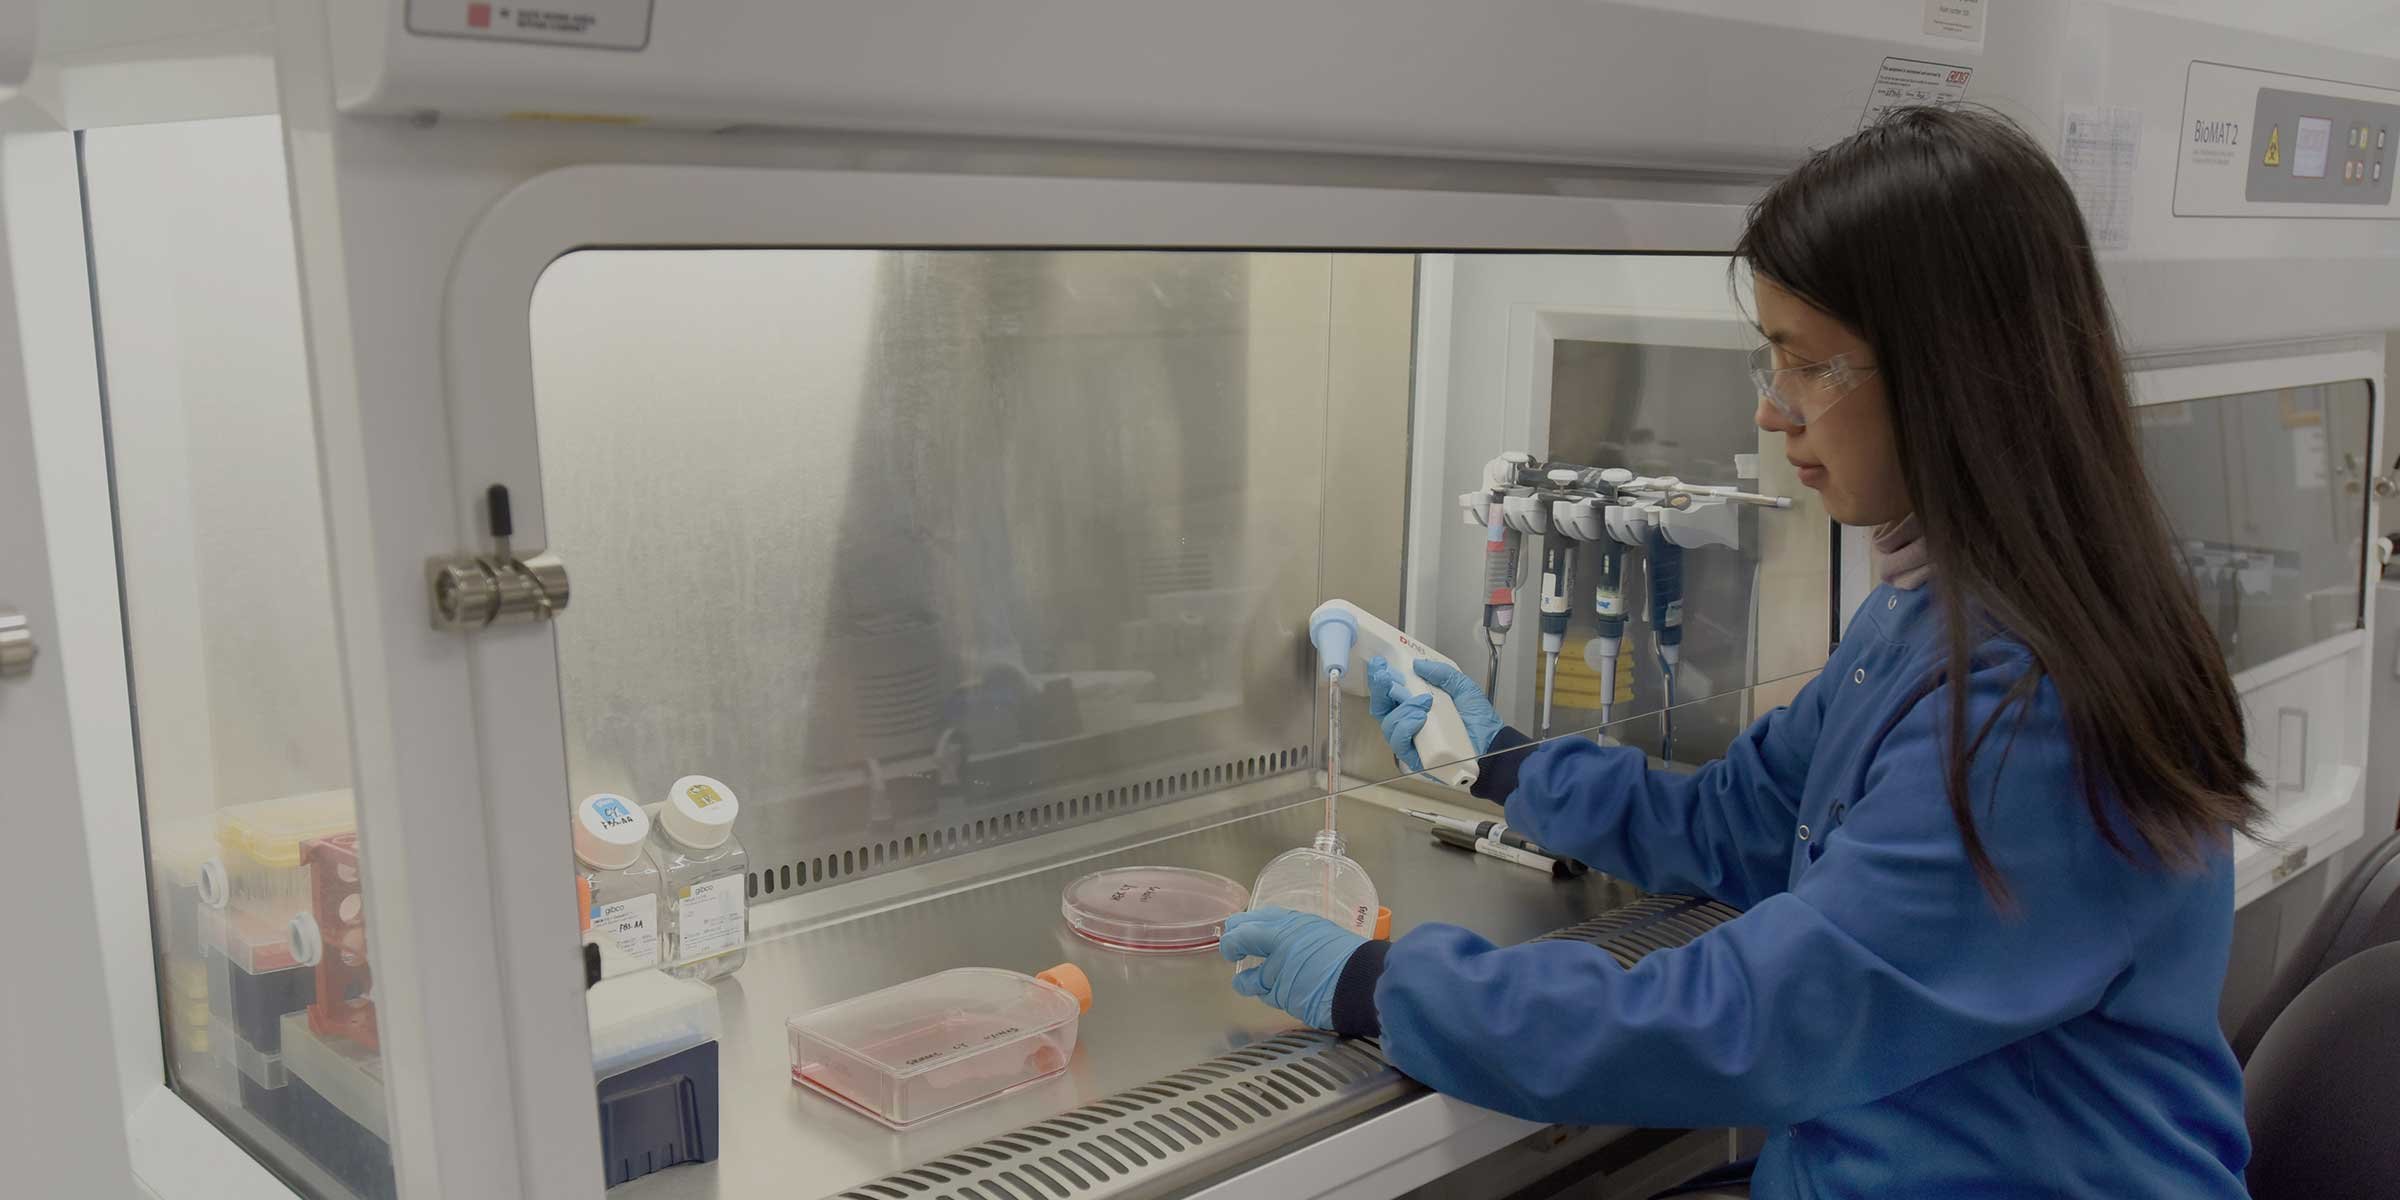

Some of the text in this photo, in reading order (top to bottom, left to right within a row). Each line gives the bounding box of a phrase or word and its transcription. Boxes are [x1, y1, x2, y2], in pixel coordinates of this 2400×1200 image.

[2194, 120, 2239, 146] BioMAT 2
[695, 884, 714, 896] gibco
[604, 904, 625, 917] gibco
